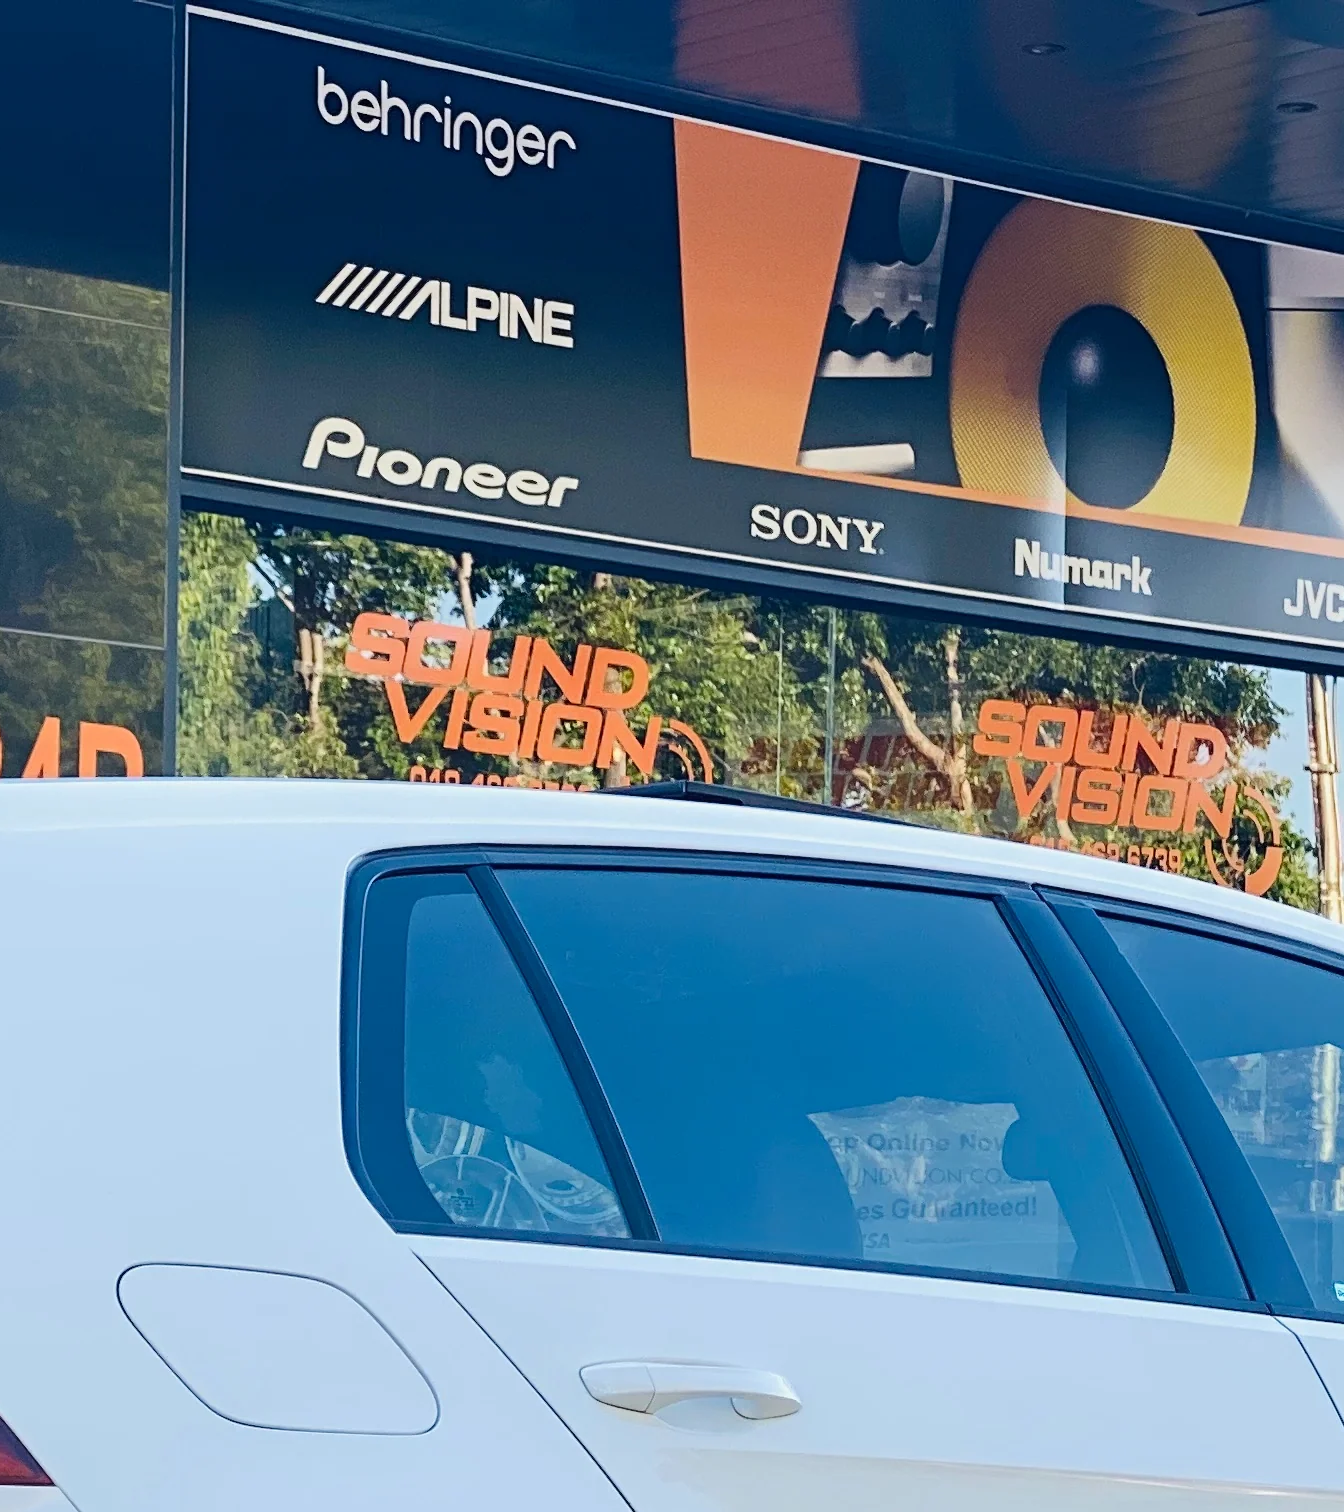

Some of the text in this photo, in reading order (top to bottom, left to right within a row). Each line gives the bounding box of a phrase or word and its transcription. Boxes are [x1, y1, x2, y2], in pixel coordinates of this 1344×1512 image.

[317, 65, 576, 177] behringer
[398, 279, 574, 348] ALPINE
[302, 416, 579, 508] Pioneer
[750, 503, 885, 555] SONY
[1013, 537, 1153, 597] Numark
[344, 611, 649, 710] SOUND
[385, 680, 662, 776] VISION
[973, 699, 1227, 780] SOUND
[1007, 759, 1237, 839] VISION
